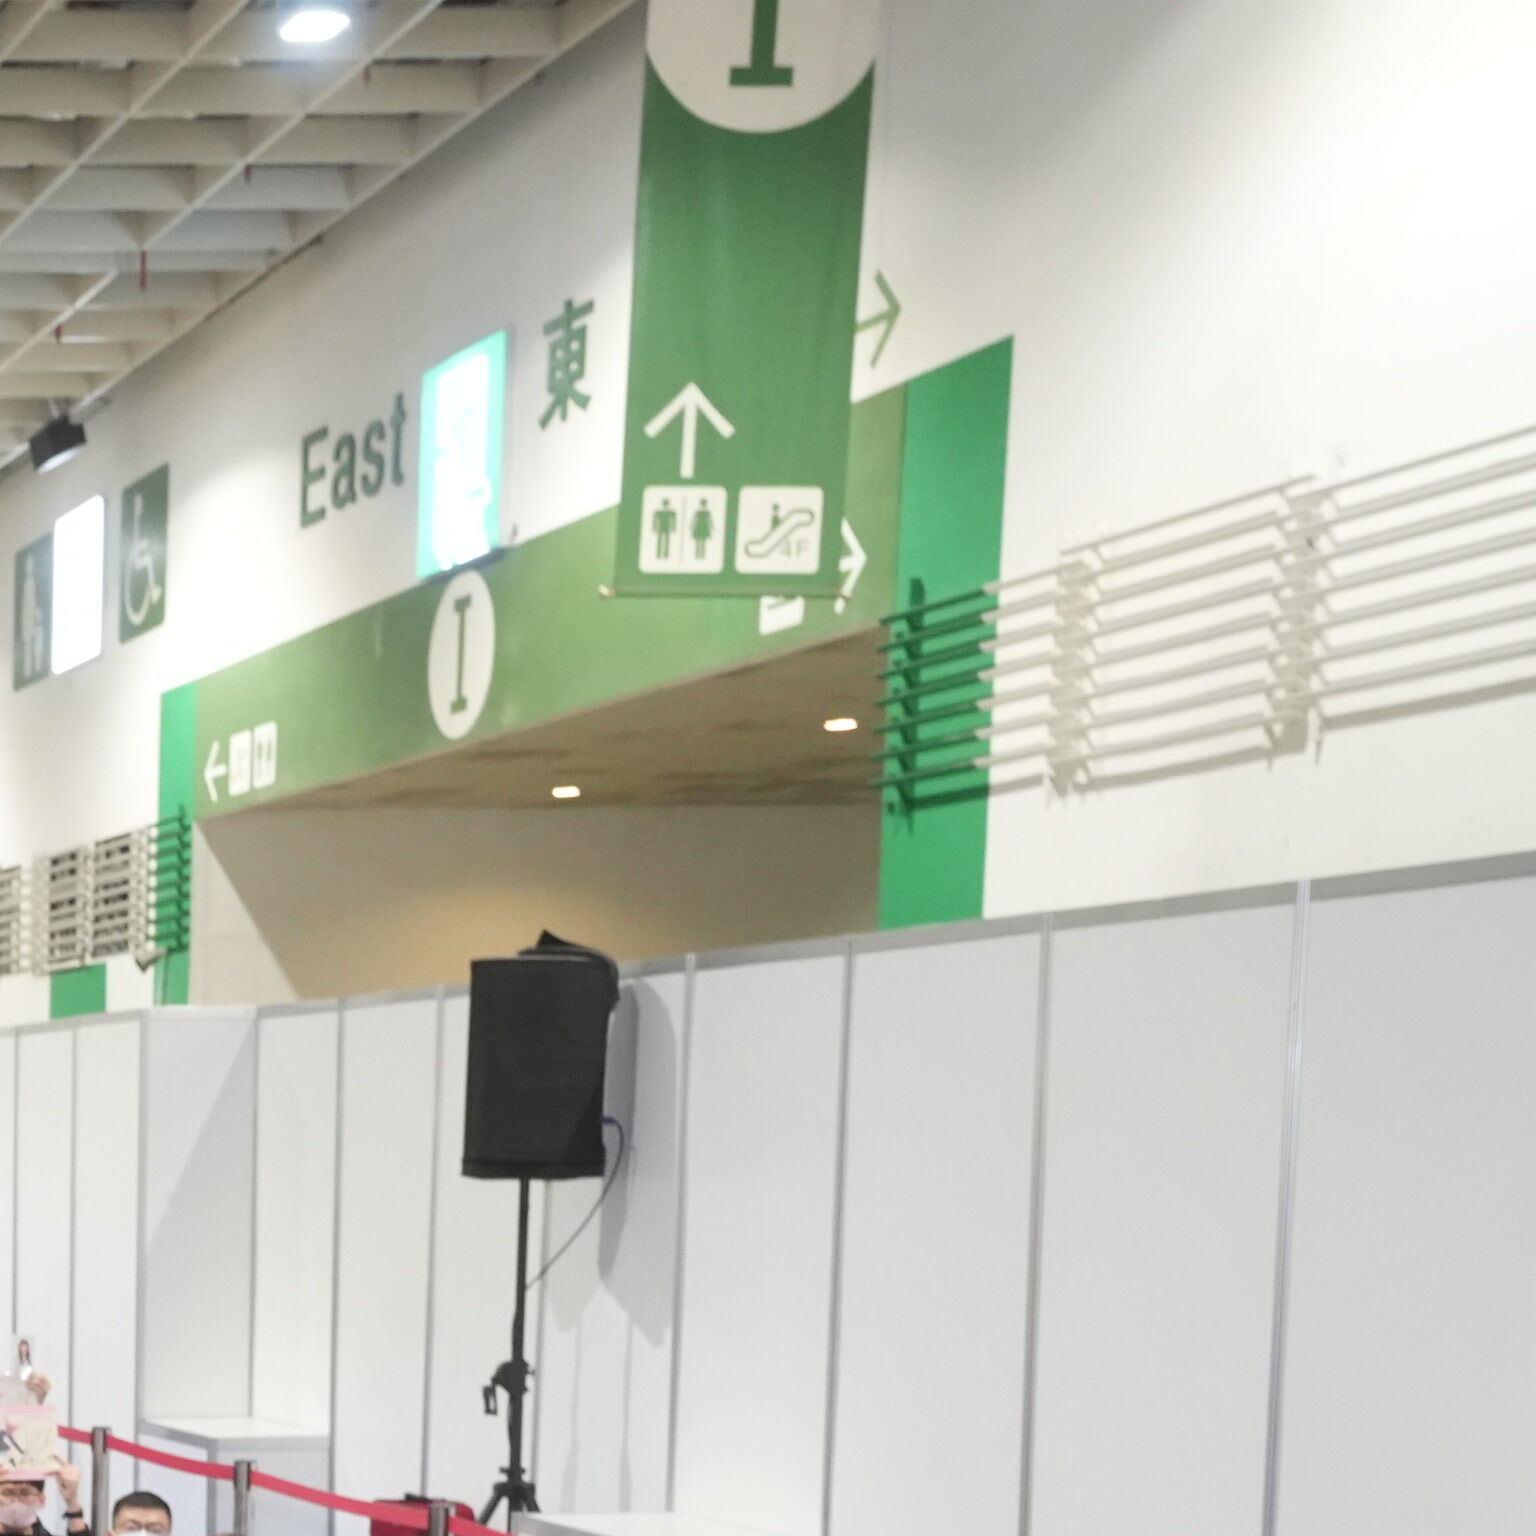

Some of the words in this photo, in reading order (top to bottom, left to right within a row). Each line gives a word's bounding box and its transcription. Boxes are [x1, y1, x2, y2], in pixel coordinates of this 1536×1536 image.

[538, 298, 596, 431] 東
[300, 391, 408, 530] East
[780, 536, 810, 560] 4F
